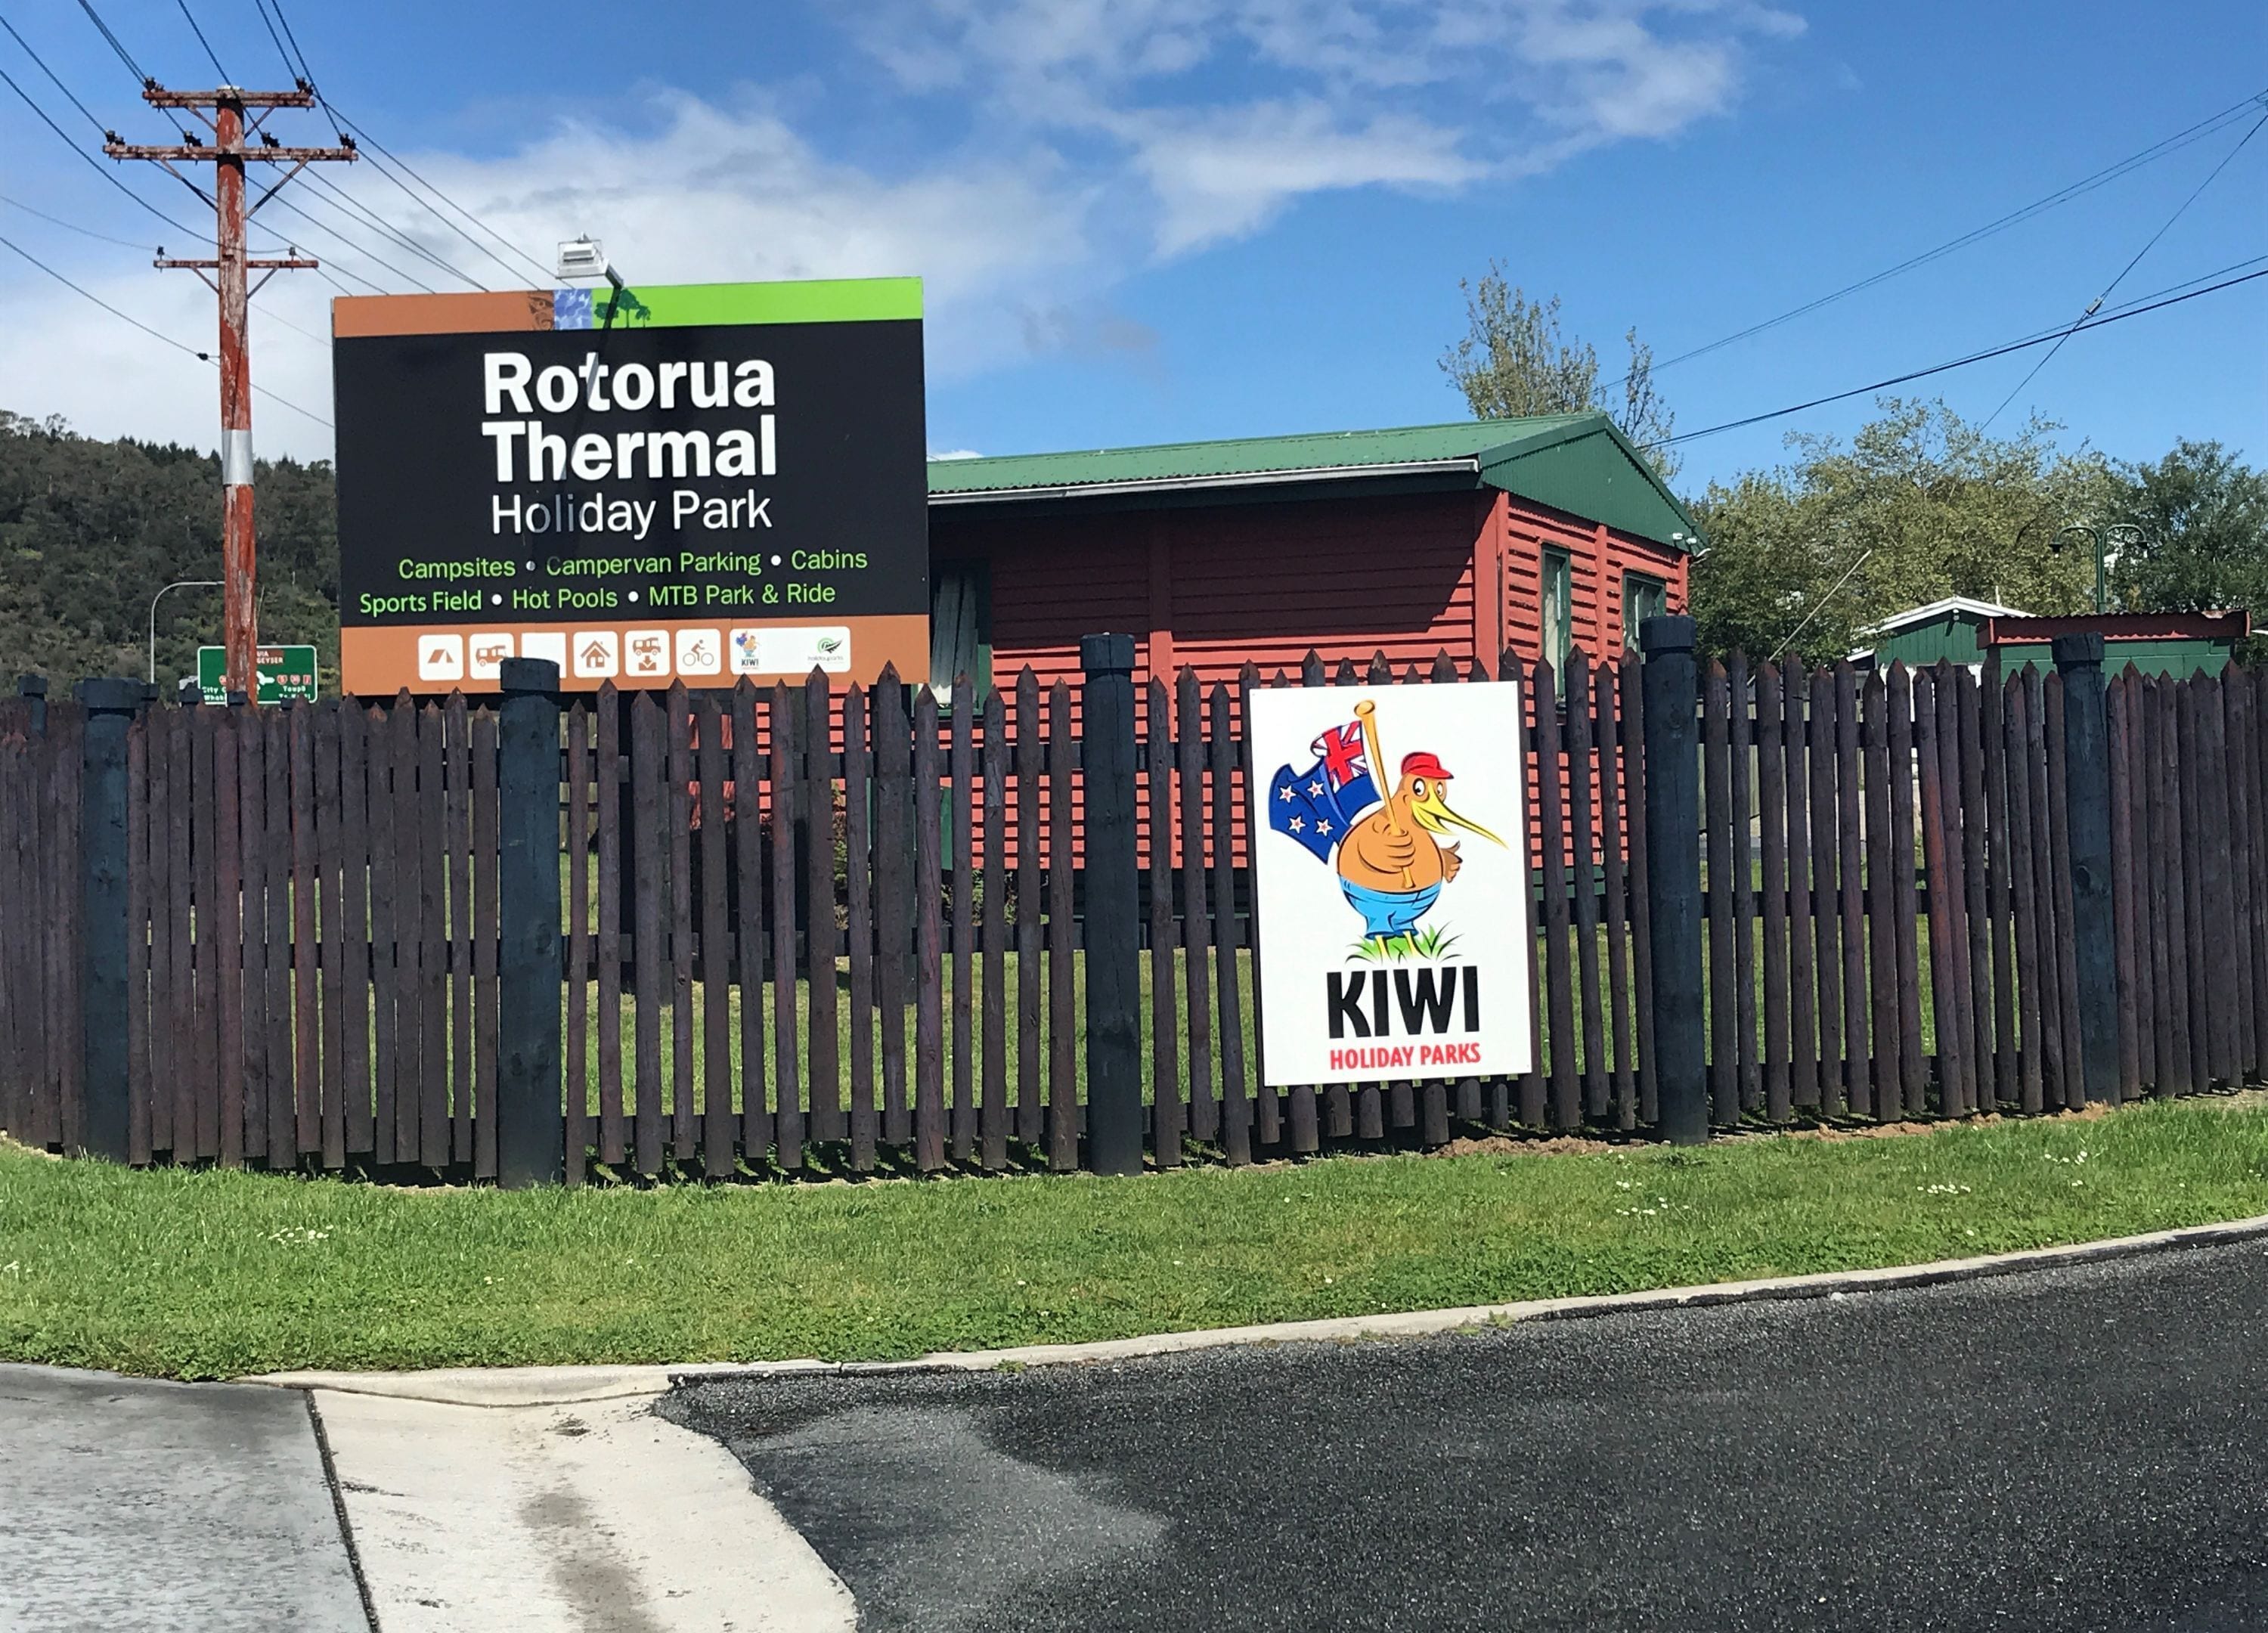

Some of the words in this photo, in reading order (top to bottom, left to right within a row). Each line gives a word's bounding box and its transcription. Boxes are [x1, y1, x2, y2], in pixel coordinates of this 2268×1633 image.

[485, 352, 775, 414] Rotorua
[482, 414, 776, 482] Thermal
[493, 492, 656, 540] Holiday
[674, 489, 772, 530] Park
[399, 557, 516, 581] Campsites
[547, 556, 671, 578] Campervan
[680, 552, 761, 576] Parking
[792, 549, 868, 570] Cabins
[360, 593, 426, 617] Sports
[432, 589, 482, 611] Field
[513, 590, 550, 609] Hot
[558, 587, 618, 609] Pools
[649, 585, 698, 606] MTB
[705, 584, 754, 605] Park
[761, 584, 779, 603] &
[787, 583, 835, 603] Ride
[1327, 966, 1479, 1039] KIWI
[1330, 1046, 1414, 1070] HOLIDAY
[1420, 1043, 1482, 1064] PARKS
